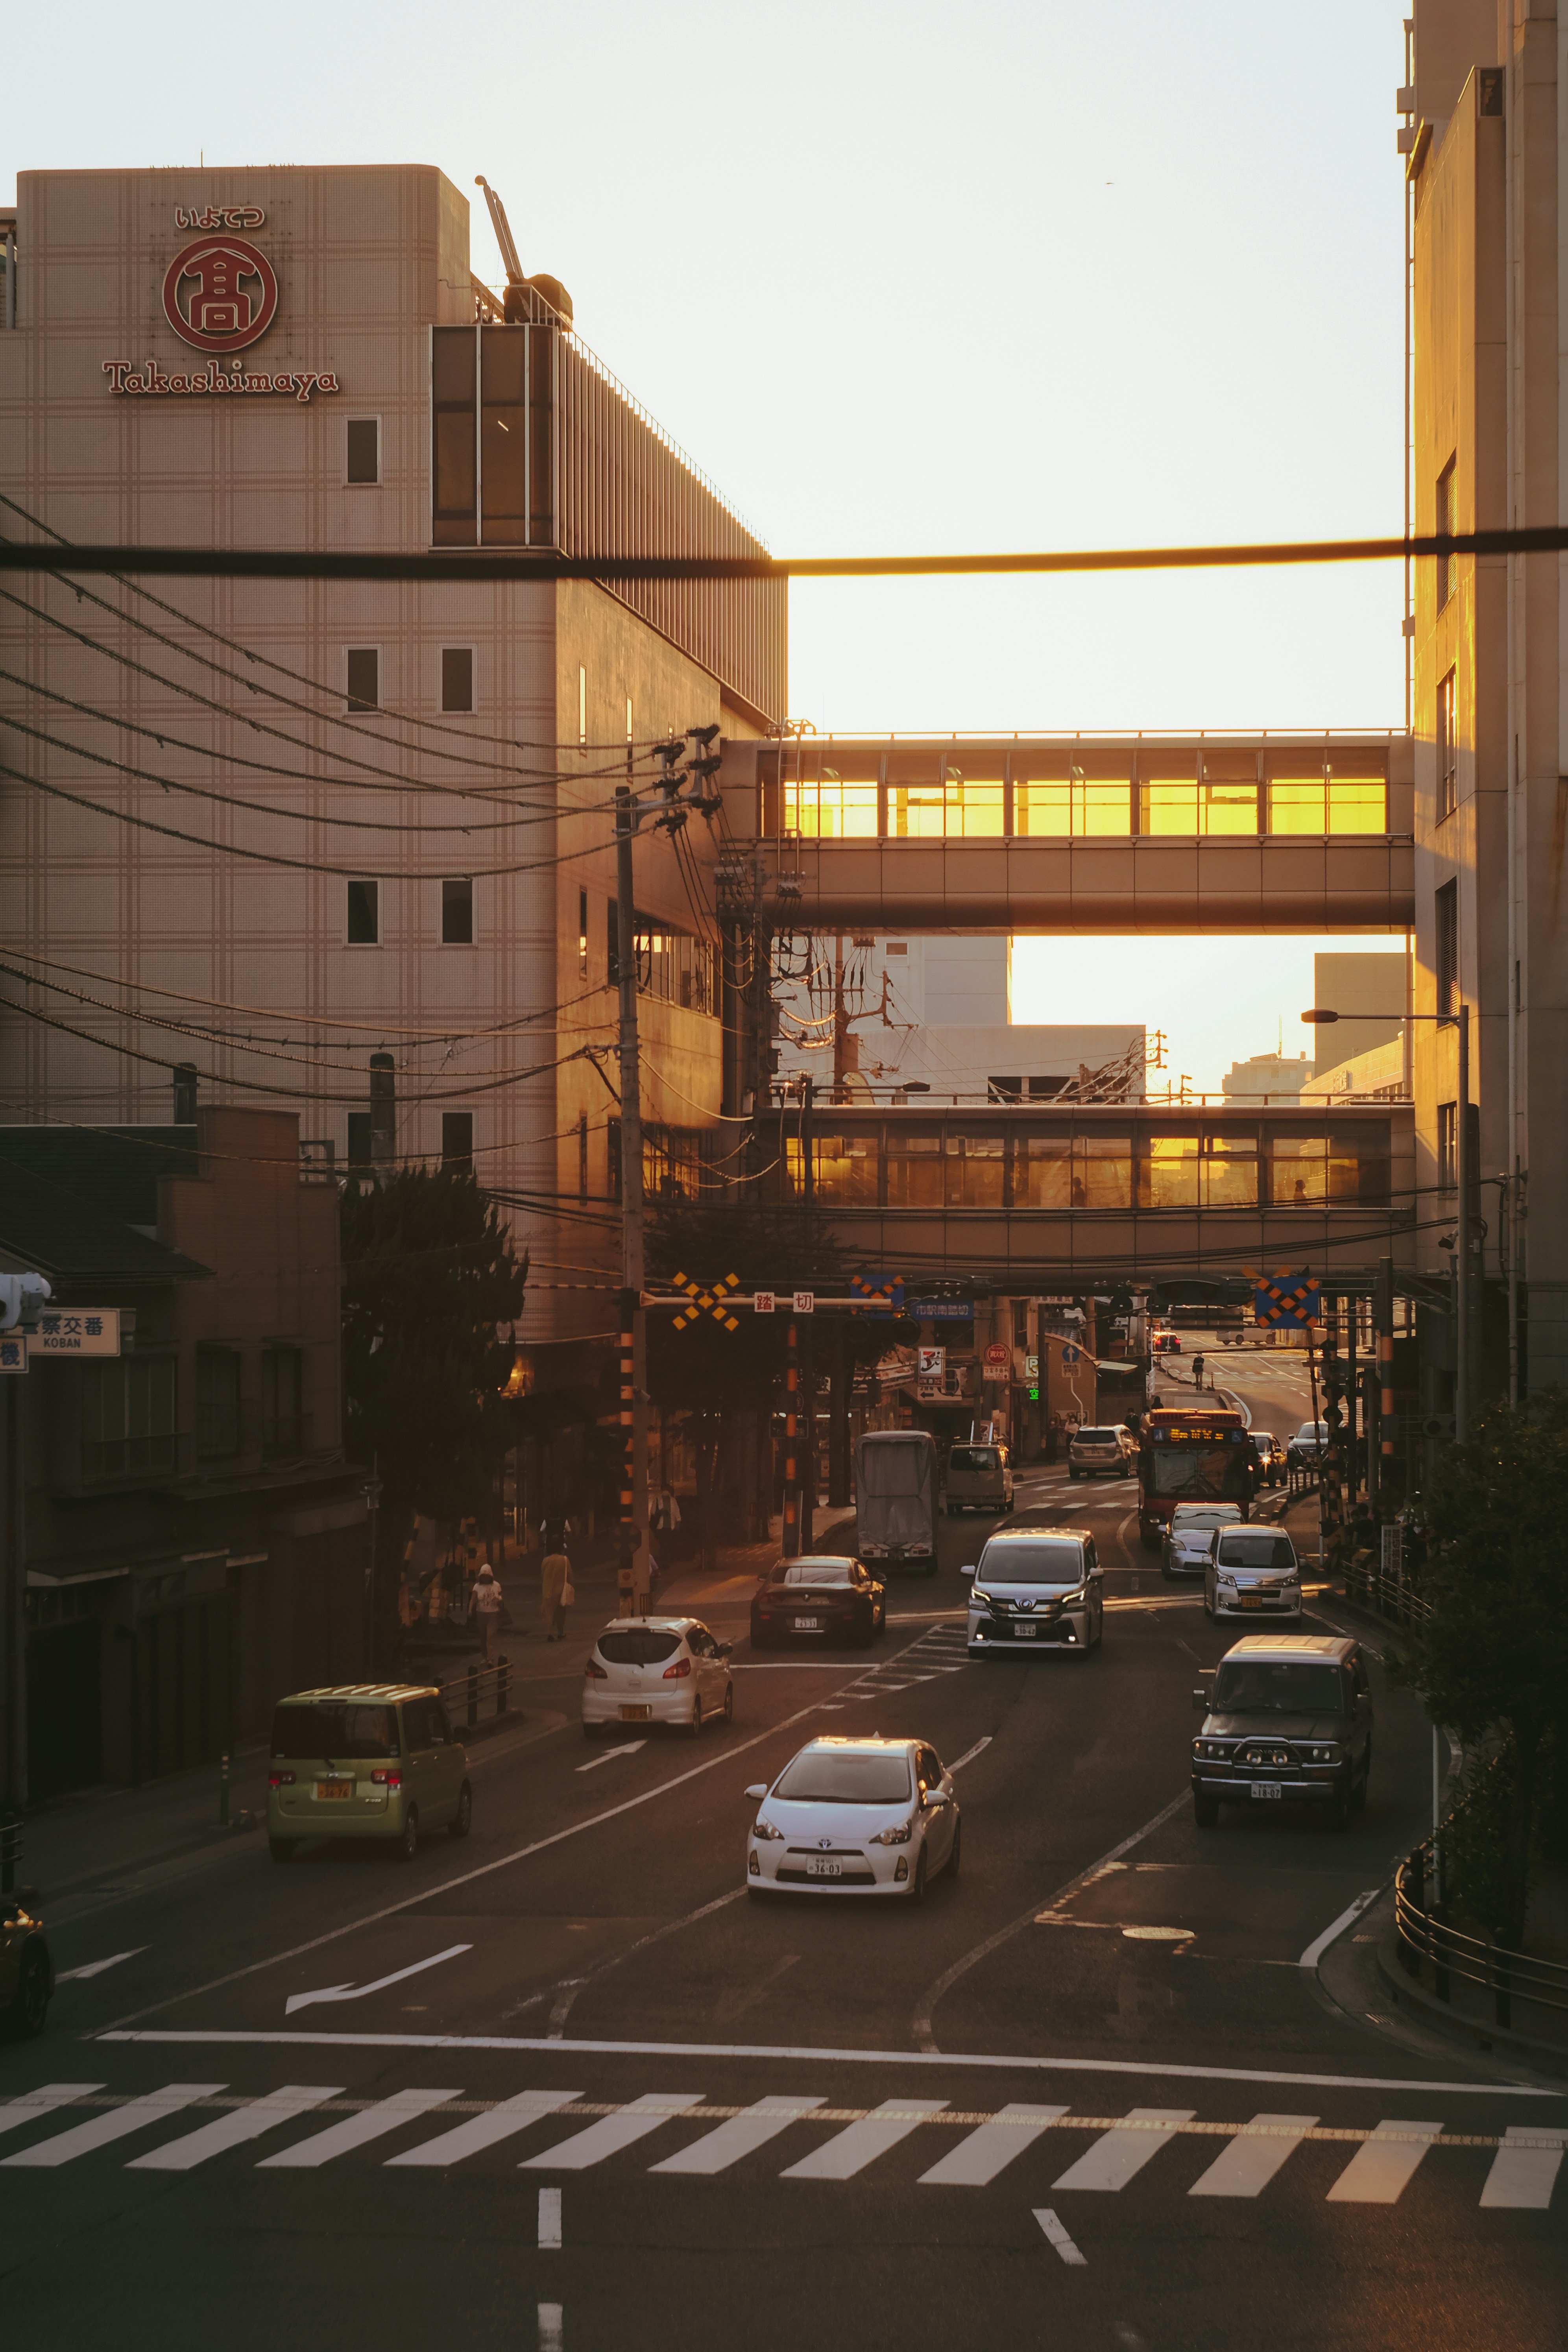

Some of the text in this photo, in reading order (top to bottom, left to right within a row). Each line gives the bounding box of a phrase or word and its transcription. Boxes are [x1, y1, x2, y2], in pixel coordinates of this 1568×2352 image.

[175, 207, 264, 229] いよてつ
[102, 360, 339, 401] Takashimaya
[44, 1338, 81, 1348] KOBAN
[1258, 1789, 1280, 1797] 18-07
[815, 1863, 840, 1874] 36-03
